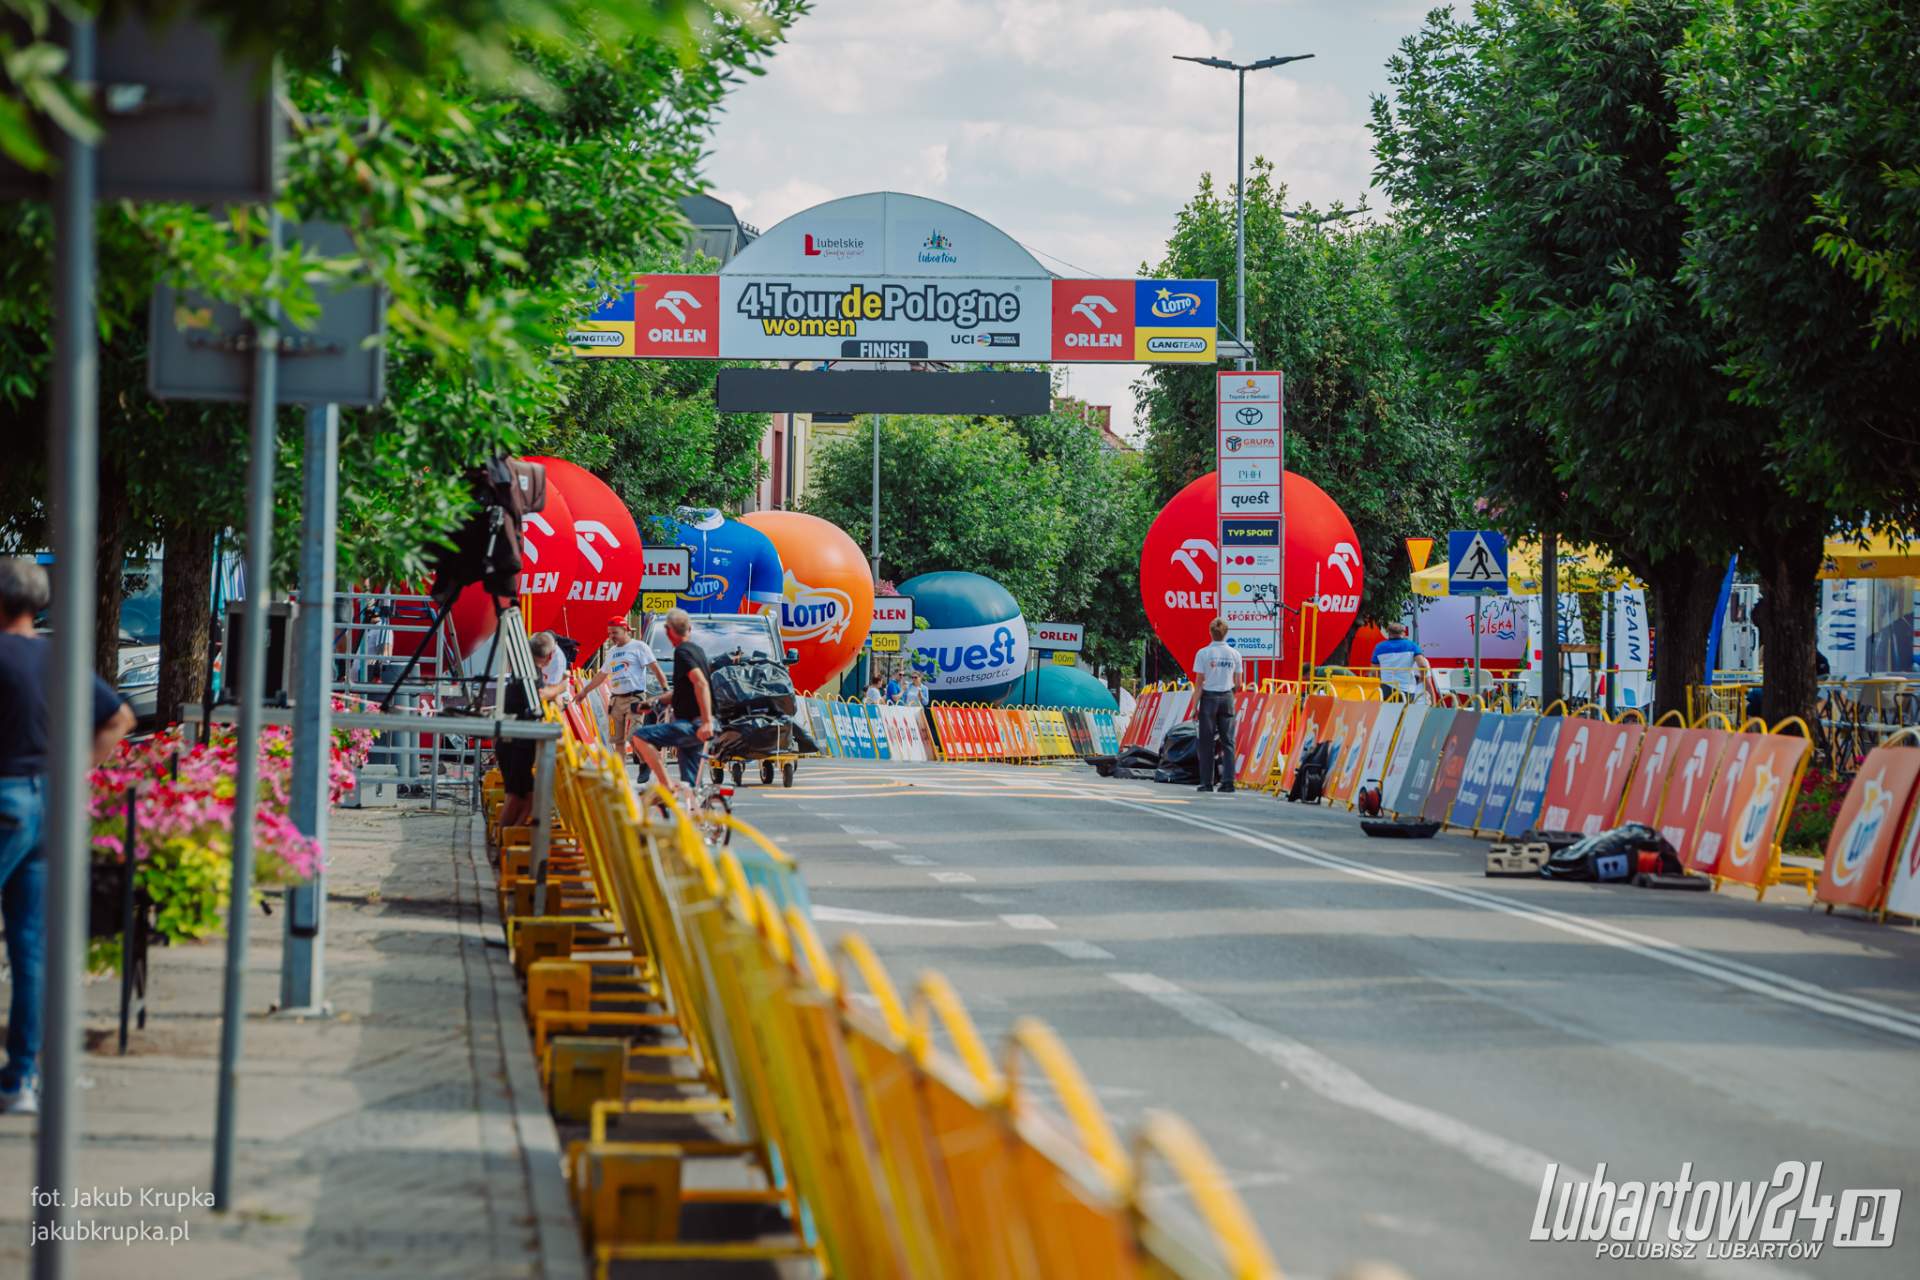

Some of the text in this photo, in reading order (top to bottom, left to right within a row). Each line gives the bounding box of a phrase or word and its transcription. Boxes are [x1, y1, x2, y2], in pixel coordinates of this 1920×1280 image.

[1162, 297, 1192, 313] LOTTO
[763, 317, 857, 336] women
[648, 328, 707, 343] ORLEN
[951, 334, 975, 344] UCI
[1064, 333, 1122, 347] ORLEN
[860, 342, 910, 358] FINISH
[1151, 340, 1203, 349] LANGTEAM
[1243, 438, 1274, 446] GRUPA
[1231, 490, 1270, 508] quest
[1228, 529, 1273, 537] TVP SPORT
[519, 572, 560, 594] LEN
[567, 580, 623, 602] RLEN
[645, 597, 674, 609] 25m
[781, 600, 837, 628] LOTTO
[873, 609, 906, 620] RLEN
[875, 637, 898, 647] 50m
[1039, 631, 1078, 641] ORLEN
[911, 626, 1016, 684] quest
